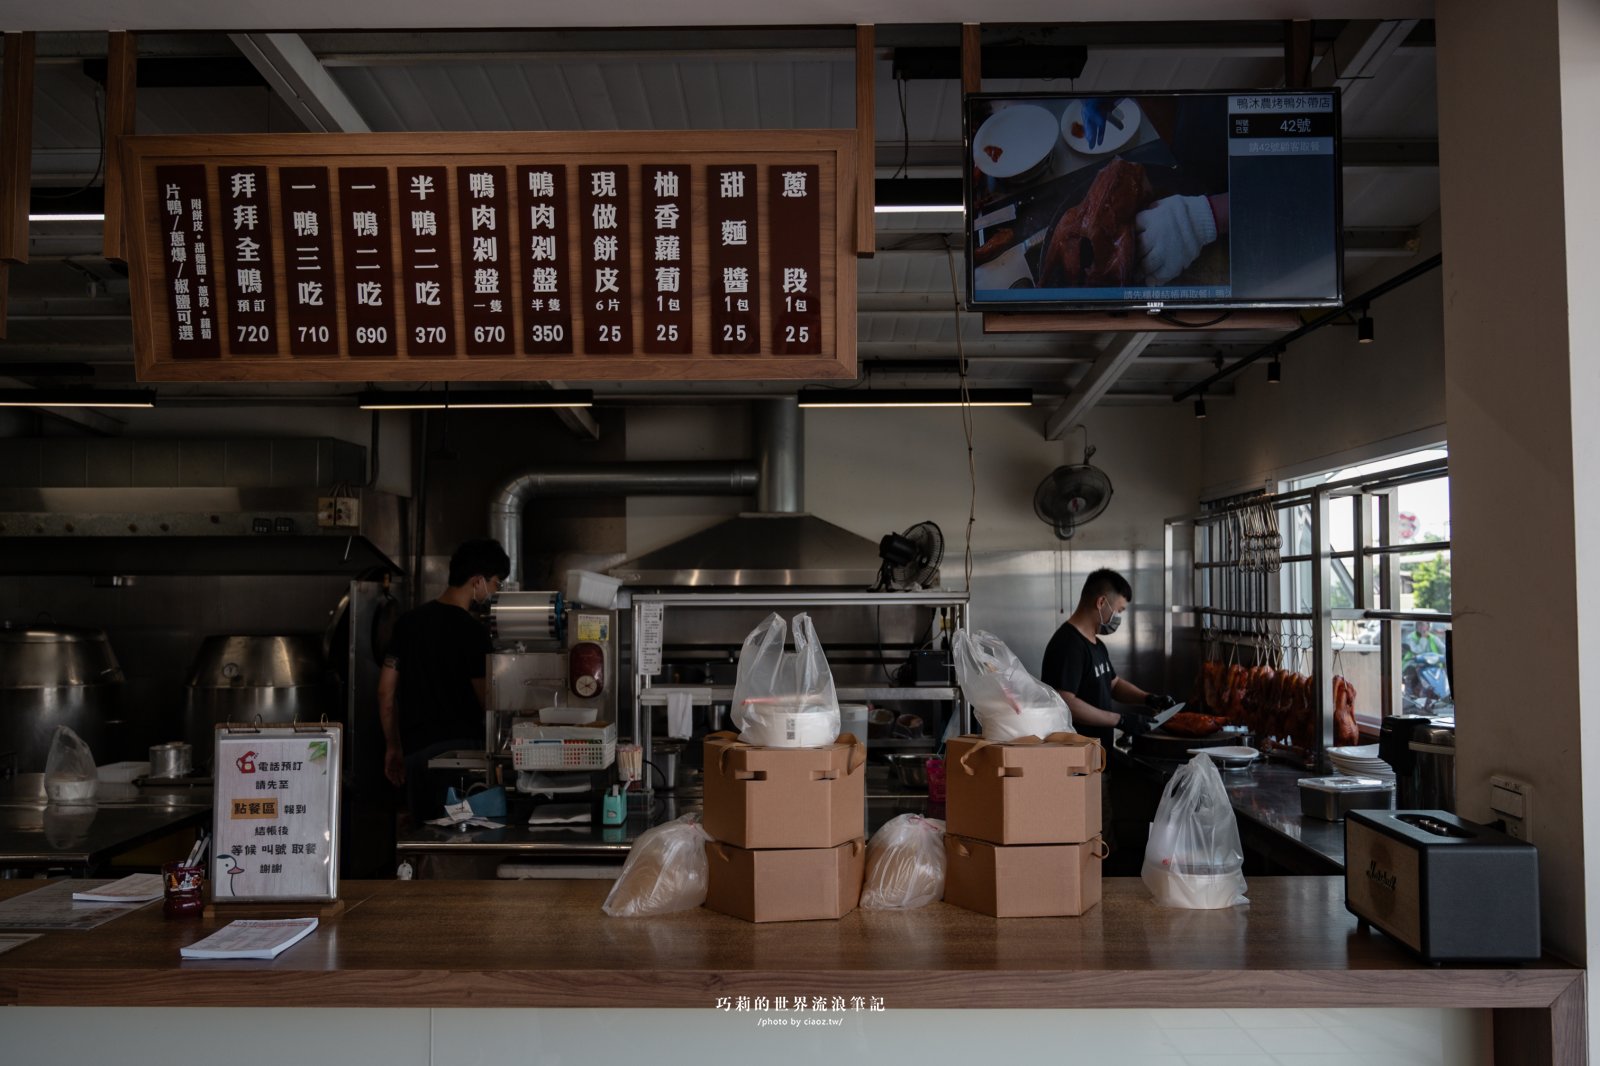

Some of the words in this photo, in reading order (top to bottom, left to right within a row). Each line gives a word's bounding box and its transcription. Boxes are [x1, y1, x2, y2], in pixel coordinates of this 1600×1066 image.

[231, 173, 262, 293] 拜拜全鴨
[470, 173, 499, 293] 鴨肉剁盤
[529, 172, 557, 292] 鴨肉剁盤
[592, 172, 619, 292] 現做餅皮
[654, 171, 680, 292] 柚香蘿蔔
[721, 172, 748, 293] 甜麵醬
[782, 172, 807, 293] 蔥段
[292, 185, 323, 305] 一鴨三吃
[352, 185, 382, 306] 一鴨二吃
[411, 175, 440, 305] 半鴨二吃
[238, 300, 265, 312] 預訂
[474, 300, 502, 312] 一隻
[532, 299, 560, 311] 半隻
[596, 299, 620, 311] 6片
[657, 296, 680, 311] 1包
[725, 296, 749, 311] 1包
[786, 296, 806, 312] 1包
[238, 326, 269, 341] 720
[299, 326, 329, 342] 710
[357, 327, 387, 343] 690
[416, 327, 446, 343] 370
[475, 326, 505, 342] 670
[533, 325, 563, 341] 350
[599, 325, 621, 341] 25
[657, 325, 678, 341] 25
[724, 325, 746, 341] 25
[786, 326, 808, 342] 25
[258, 762, 303, 771] 電話預訂
[256, 780, 288, 789] 請先至
[235, 802, 276, 815] 點餐區
[284, 805, 306, 814] 報到
[255, 826, 288, 836] 結帳後
[231, 844, 258, 857] 等候
[262, 844, 286, 855] 叫號
[291, 842, 318, 856] 取餐
[260, 864, 282, 873] 謝謝
